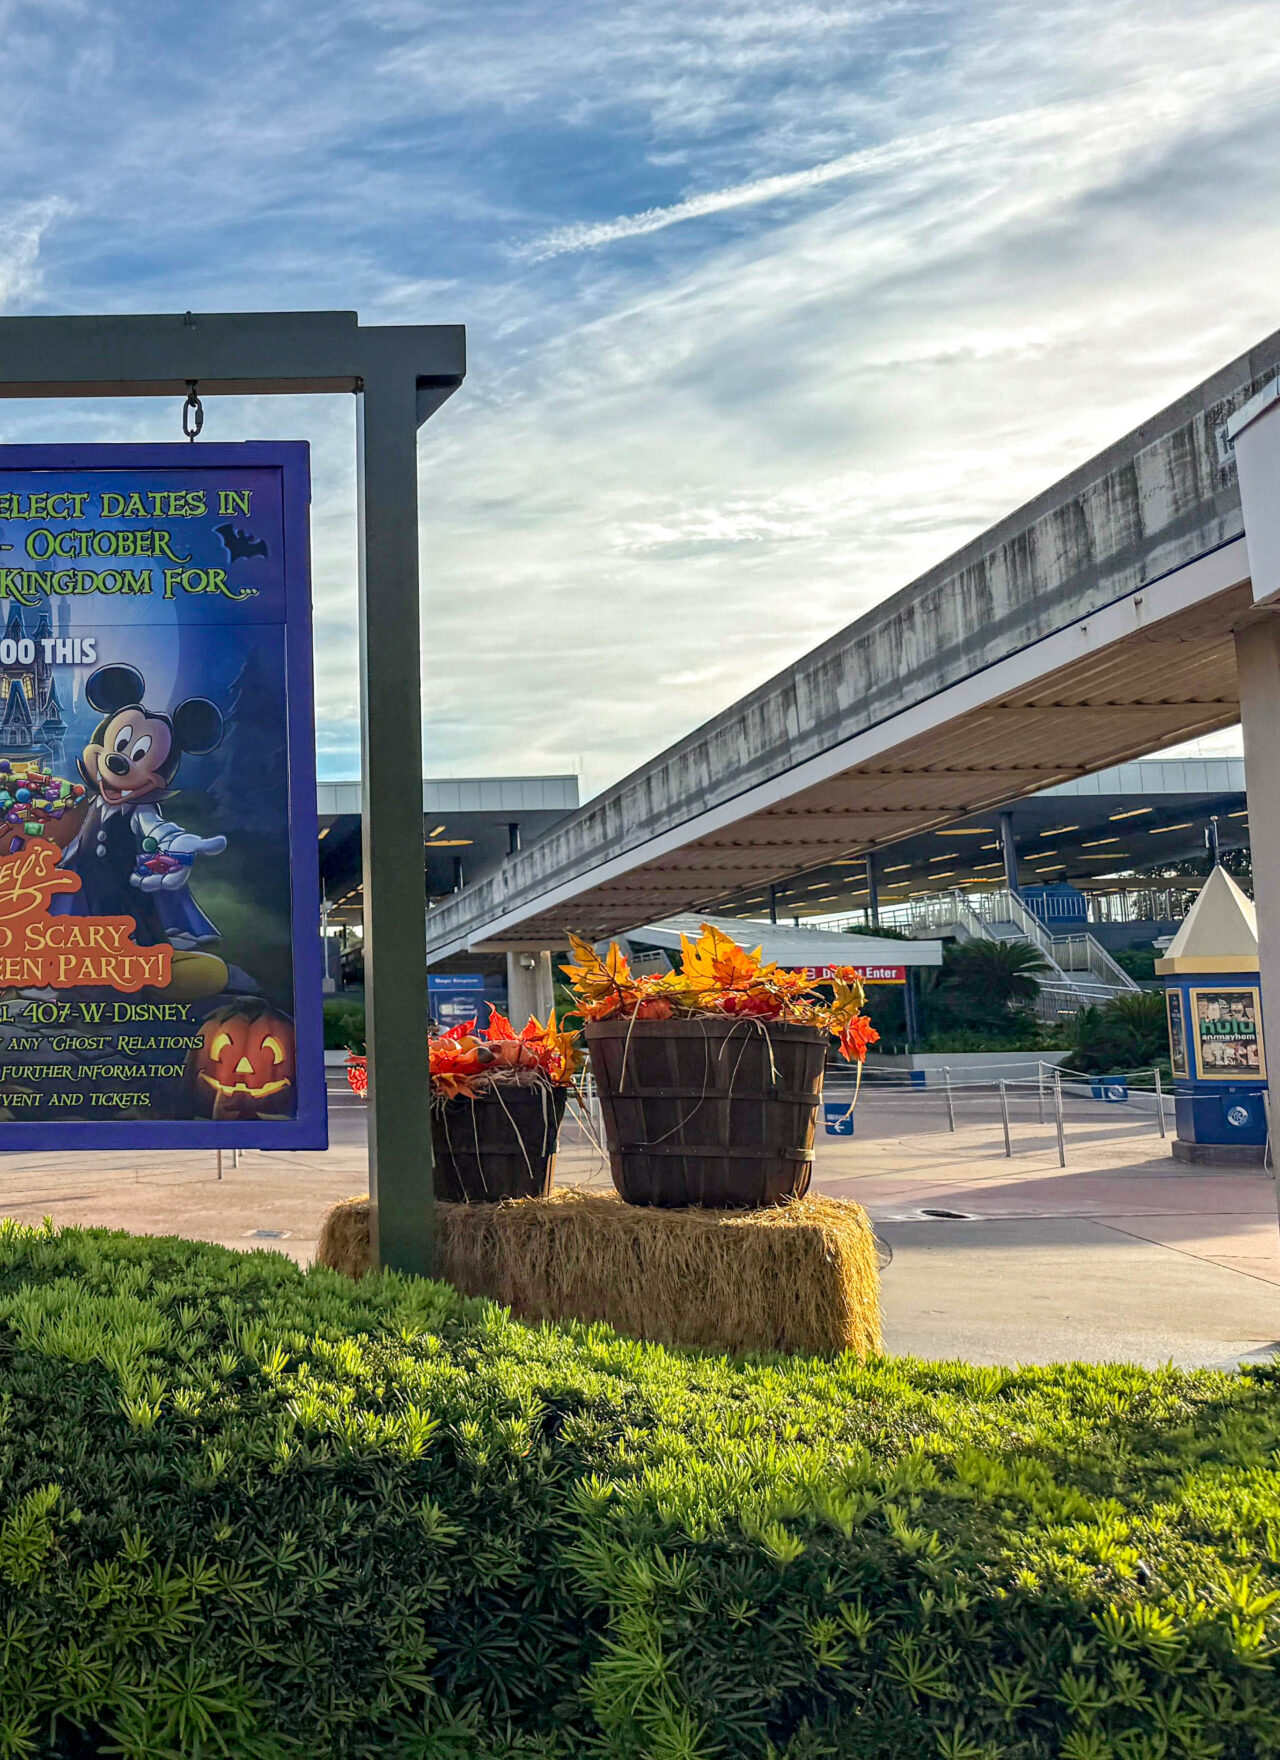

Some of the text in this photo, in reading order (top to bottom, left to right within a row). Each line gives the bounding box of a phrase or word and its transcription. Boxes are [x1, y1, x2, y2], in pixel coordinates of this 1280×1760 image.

[100, 490, 208, 518] DATES
[218, 490, 253, 517] IN
[0, 543, 14, 552] -
[25, 528, 192, 564] OCTOBER
[41, 637, 97, 665] THIS
[24, 921, 128, 955] SCARY
[57, 953, 165, 986] PARTY!
[865, 967, 897, 978] Enter
[22, 1001, 196, 1024] 407-W-DISNEY.
[1201, 1017, 1255, 1035] hulu
[8, 1036, 43, 1051] ANY
[49, 1035, 112, 1052] "GHOST"
[118, 1035, 204, 1056] RELATIONS
[0, 1065, 79, 1082] FURTHER
[78, 1064, 186, 1081] INFORMATION
[49, 1093, 83, 1106] AND
[90, 1092, 151, 1109] TICKETS.
